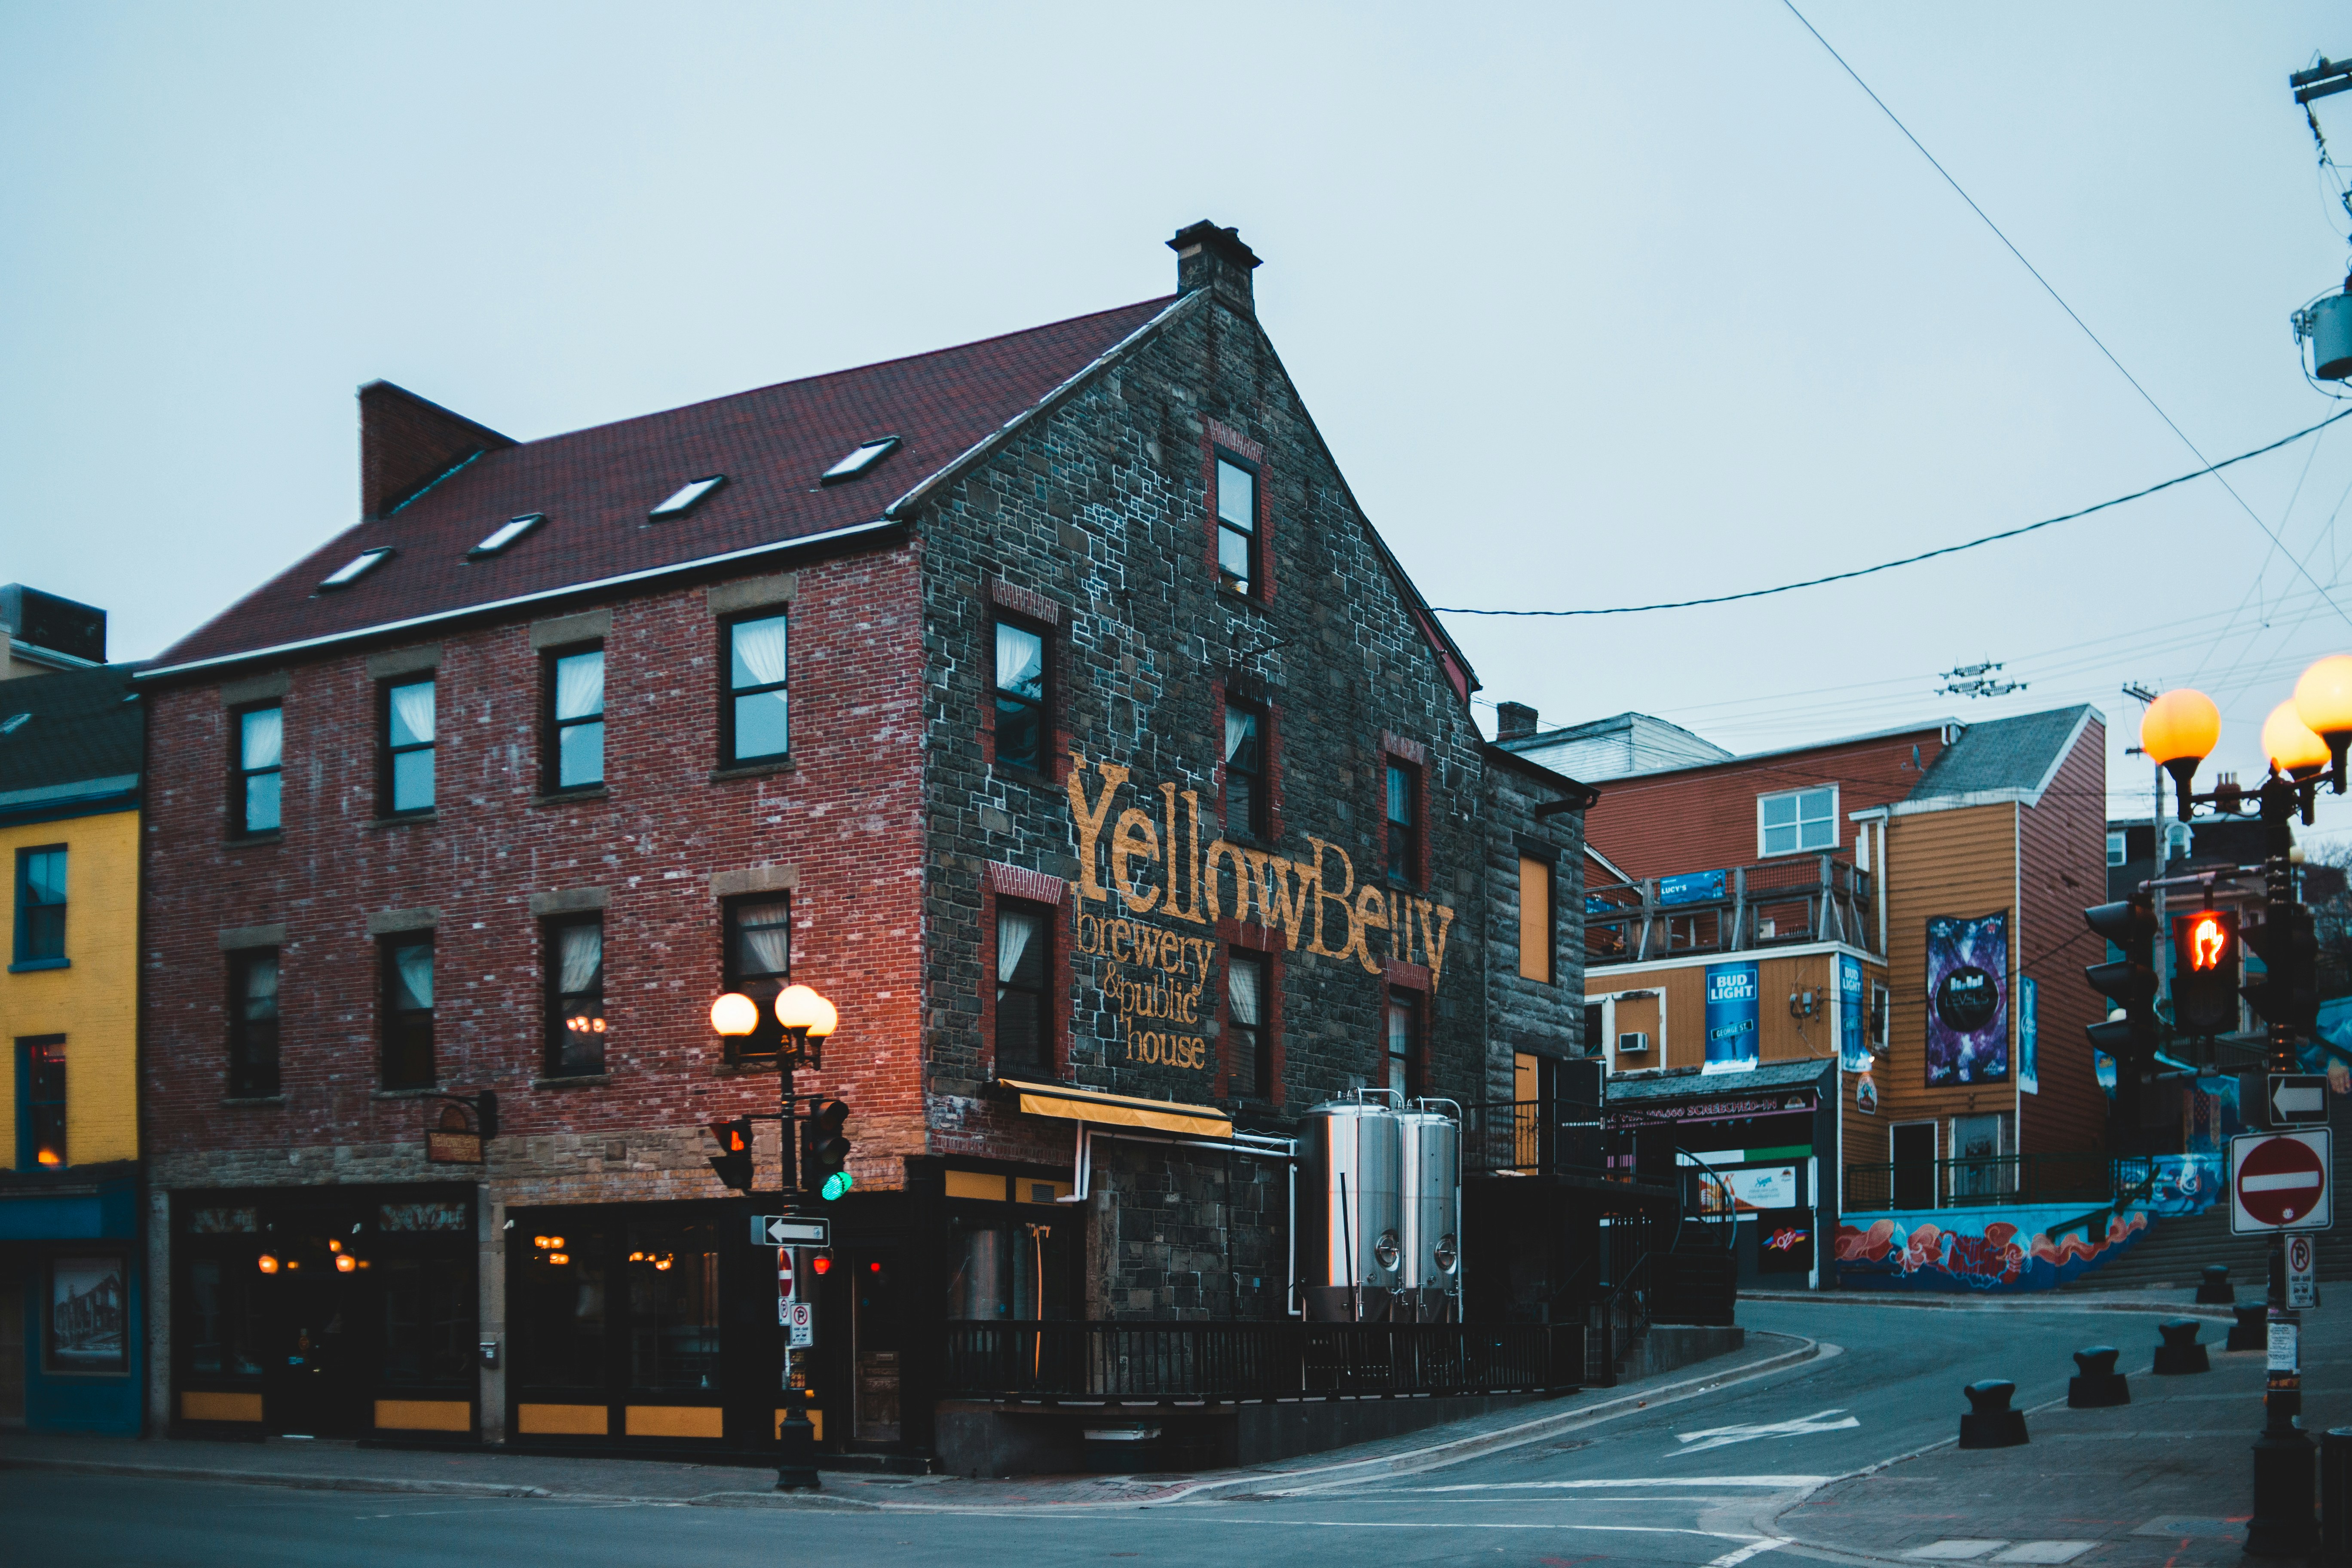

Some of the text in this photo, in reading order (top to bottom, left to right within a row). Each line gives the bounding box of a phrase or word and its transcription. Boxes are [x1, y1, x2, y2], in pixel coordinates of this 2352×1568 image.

[1661, 884, 1687, 894] LUCY'S
[1077, 894, 1216, 996] brewery
[1845, 966, 1859, 980] BUD
[1717, 974, 1747, 988] BUD
[1843, 977, 1861, 992] LIGHT
[1711, 985, 1753, 1000] LIGHT
[1945, 992, 1989, 1008] LEVELS
[1716, 1025, 1737, 1038] GEORGE
[1126, 1017, 1205, 1070] house
[1687, 1098, 1776, 1116] SCREECHED-IN
